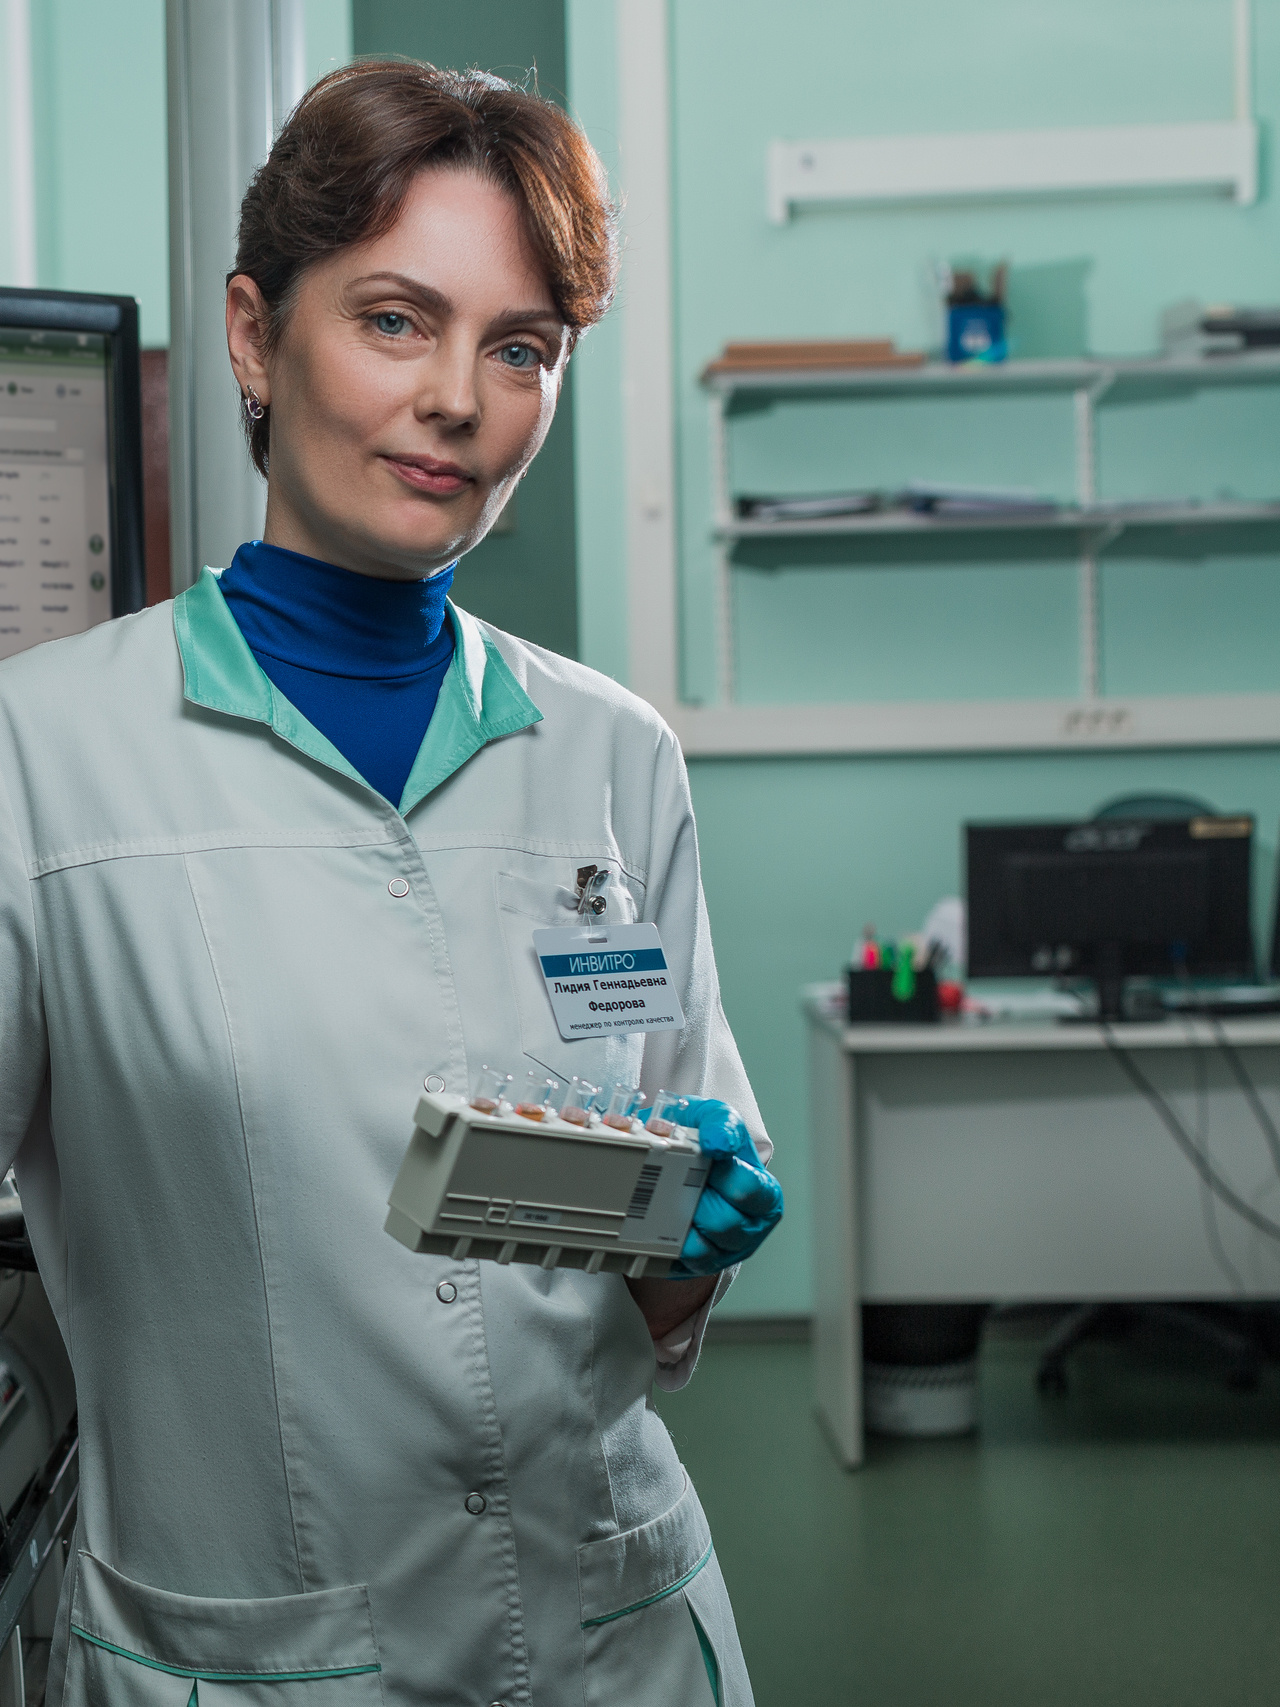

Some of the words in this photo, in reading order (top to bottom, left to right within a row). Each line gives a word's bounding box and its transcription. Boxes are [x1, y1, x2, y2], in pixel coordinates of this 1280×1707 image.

[569, 953, 635, 973] ИНВИТРО
[554, 982, 591, 994] Лидия
[593, 976, 667, 991] Геннадьевна
[588, 998, 646, 1012] Федорова
[569, 1022, 603, 1031] менеджер
[604, 1021, 612, 1029] по
[613, 1018, 645, 1027] контролю
[646, 1015, 674, 1024] качества
